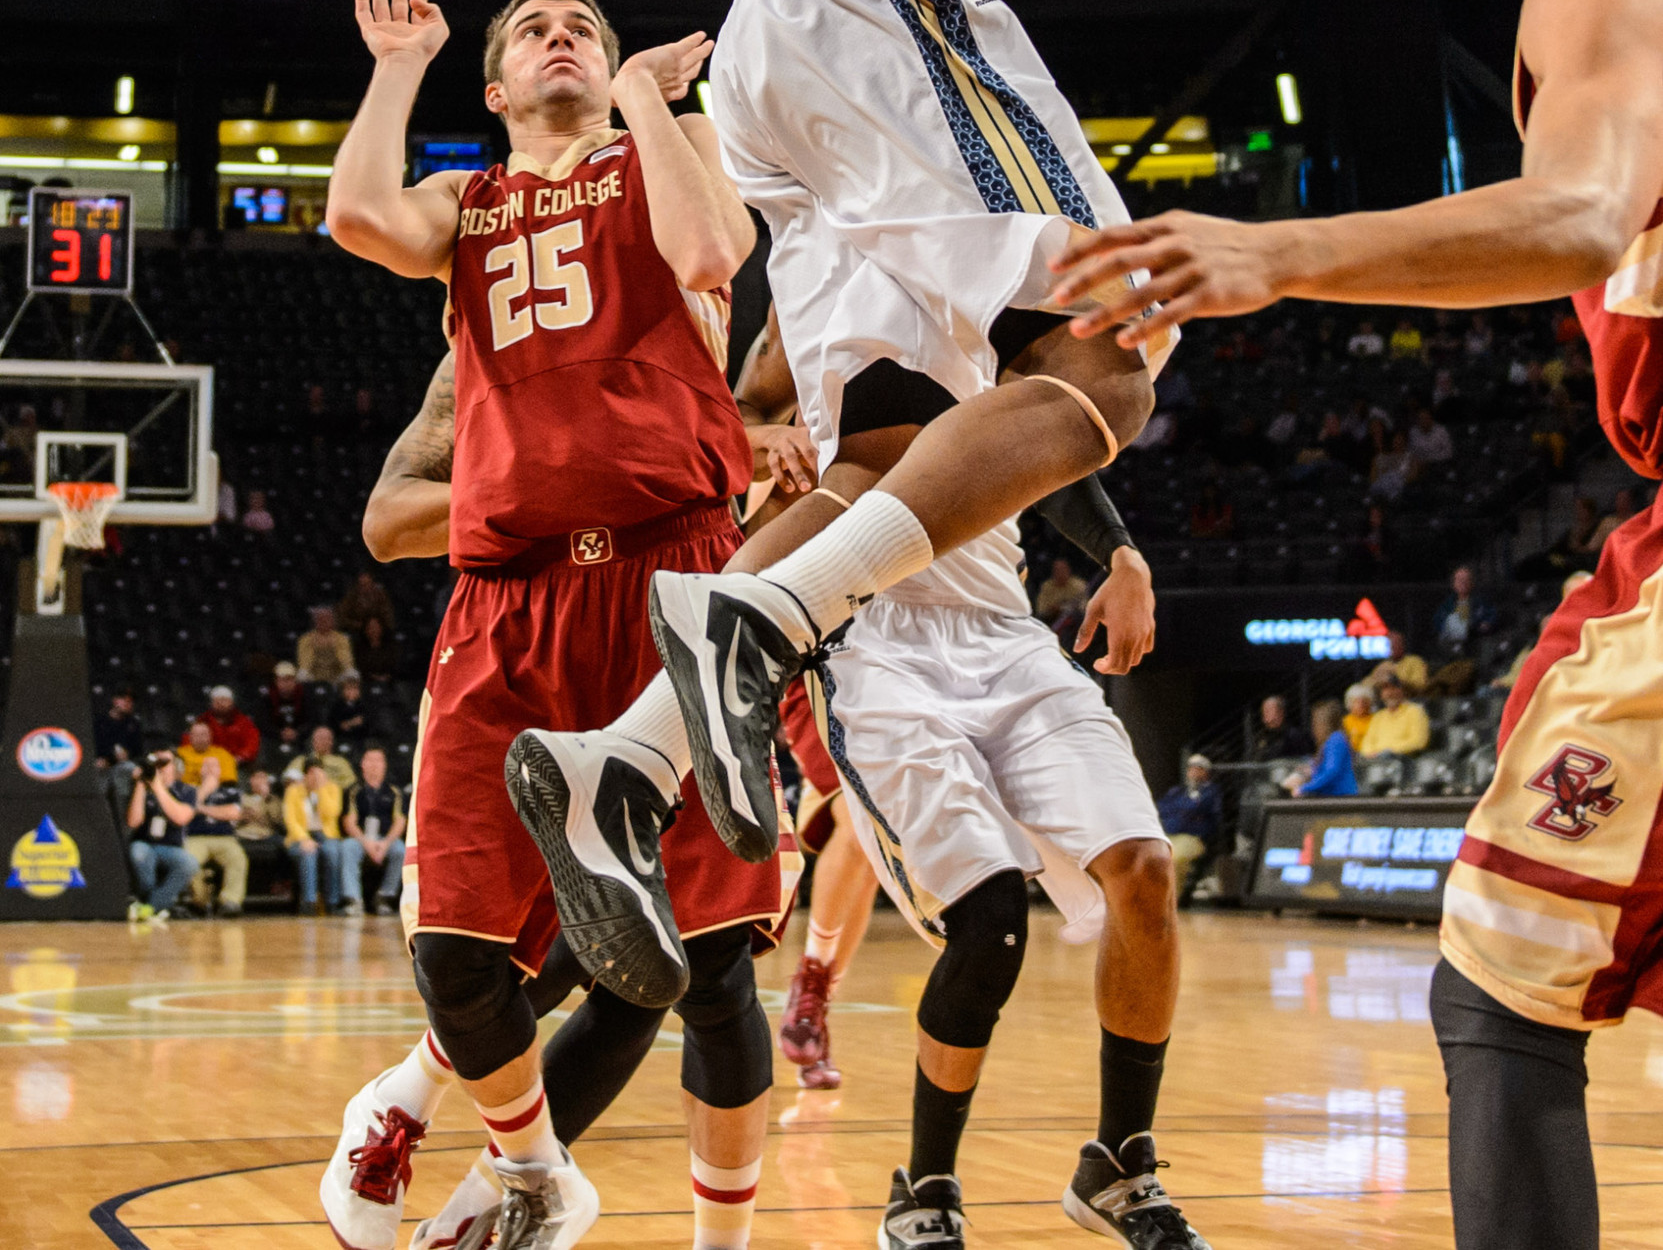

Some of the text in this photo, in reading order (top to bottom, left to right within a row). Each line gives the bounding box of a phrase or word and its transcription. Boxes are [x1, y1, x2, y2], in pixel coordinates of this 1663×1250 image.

[533, 169, 623, 218] COLLEGE
[50, 229, 112, 282] 31
[484, 217, 594, 352] 25
[1244, 617, 1347, 645] GEORGIA
